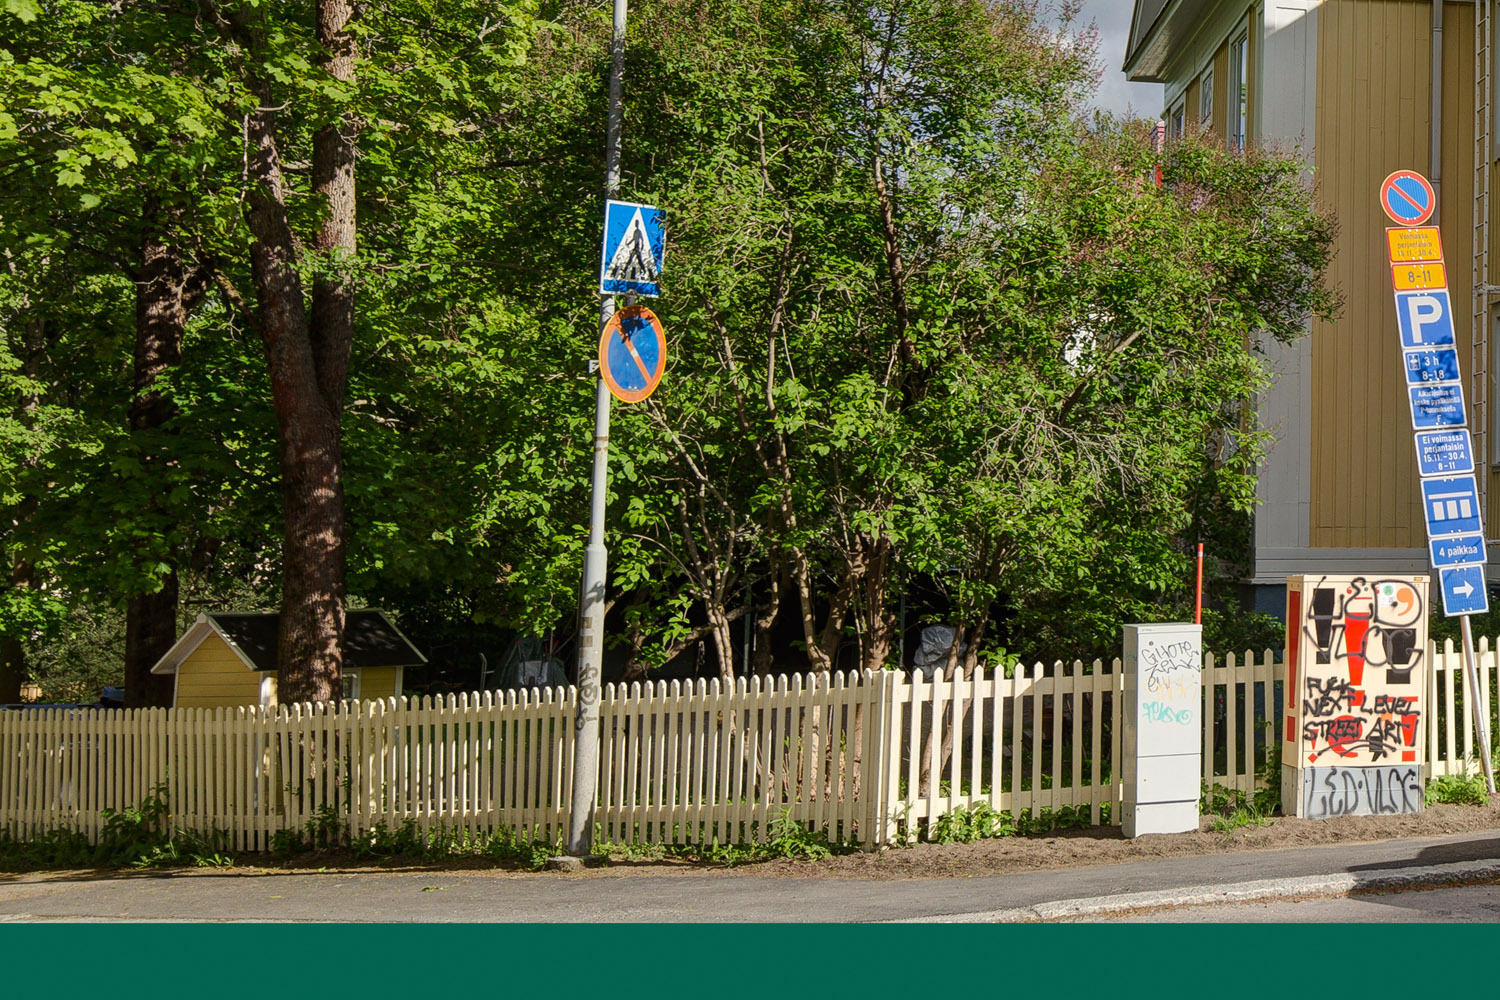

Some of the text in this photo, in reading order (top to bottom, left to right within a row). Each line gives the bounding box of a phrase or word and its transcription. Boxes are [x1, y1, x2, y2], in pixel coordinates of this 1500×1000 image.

[1407, 296, 1443, 344] P
[1424, 355, 1440, 367] 3 h
[1422, 434, 1464, 445] Ei voimassa
[1423, 443, 1465, 454] perjantaisin
[1439, 545, 1478, 558] 4 paikkaa
[1303, 717, 1368, 742] STREET
